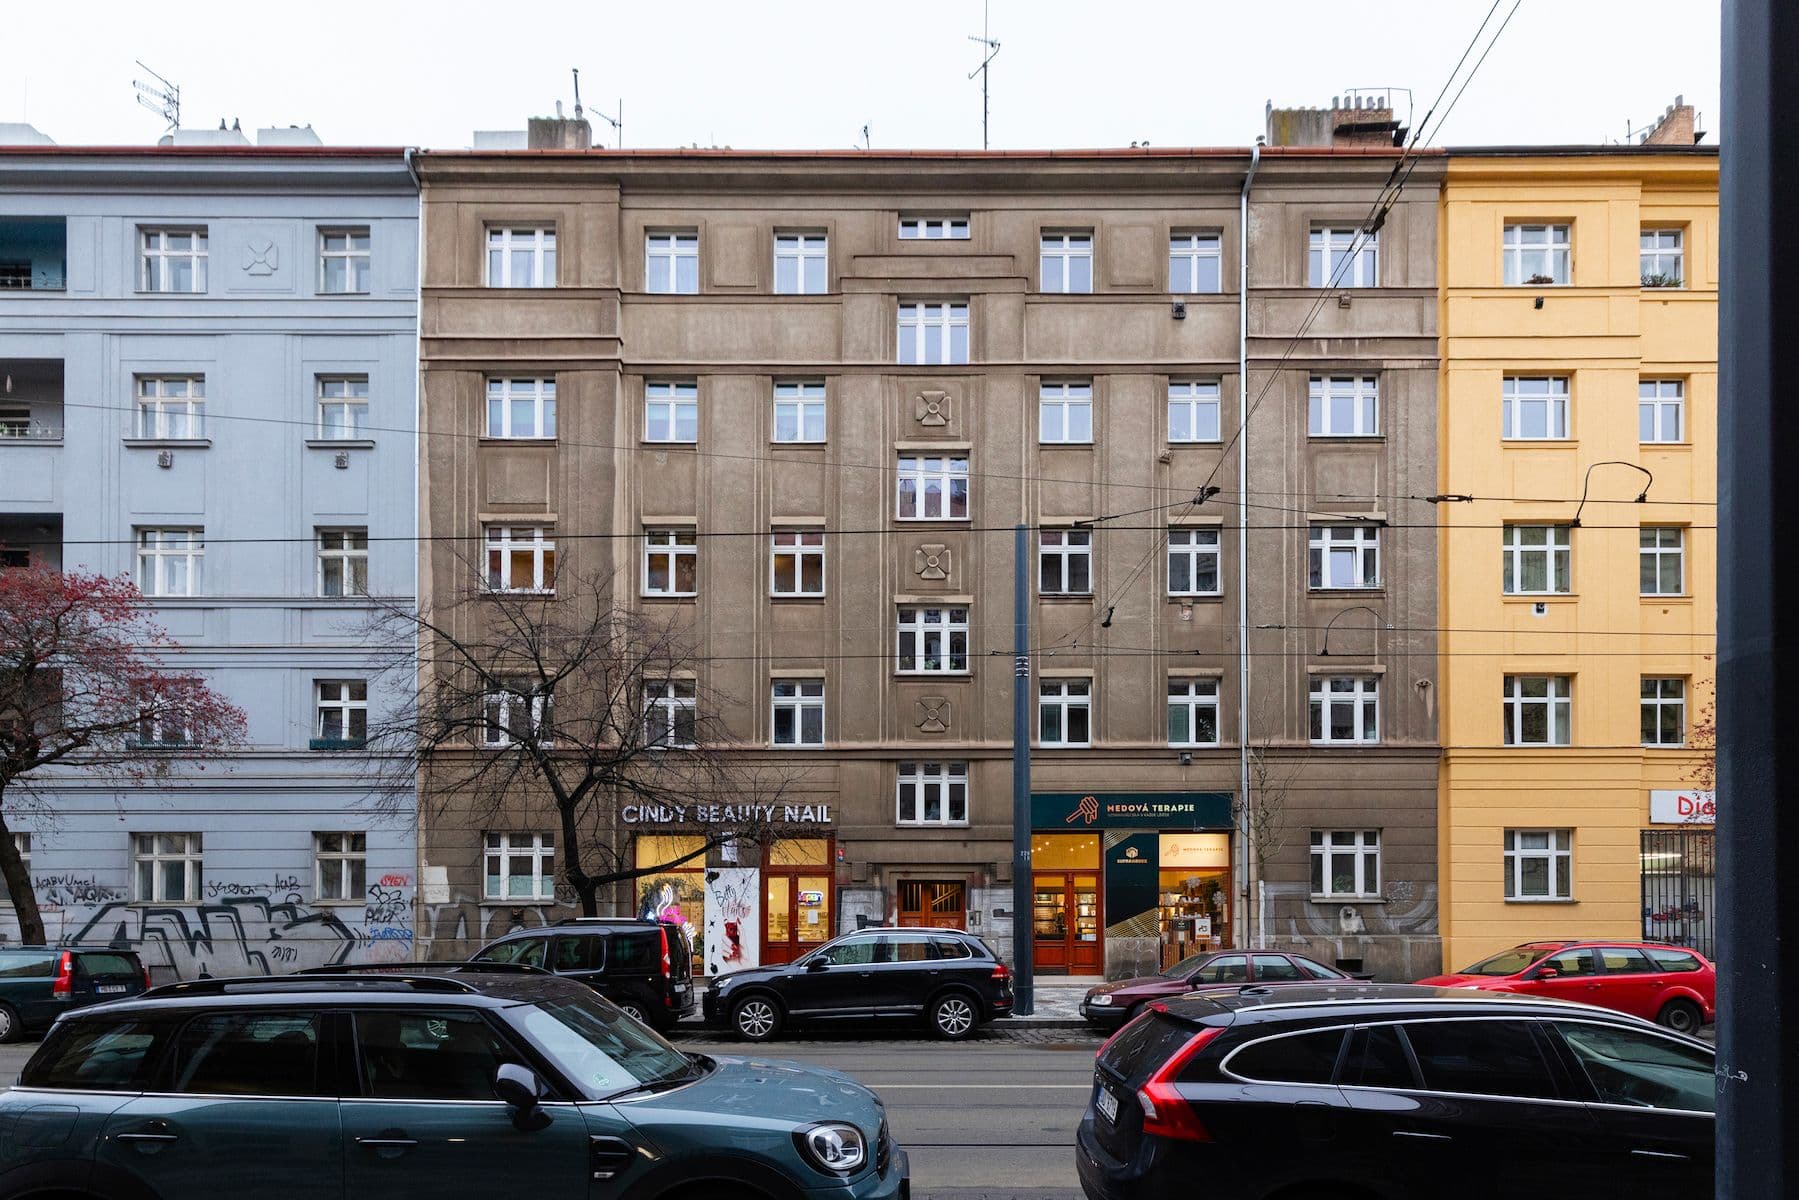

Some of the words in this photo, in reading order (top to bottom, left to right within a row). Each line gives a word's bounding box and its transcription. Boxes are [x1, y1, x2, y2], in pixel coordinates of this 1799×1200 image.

[621, 805, 686, 823] CINDY
[696, 804, 776, 823] BEAUTY
[784, 805, 832, 823] NAIL
[1107, 802, 1149, 812] MEDOVÁ
[1152, 803, 1195, 812] TERAPIE
